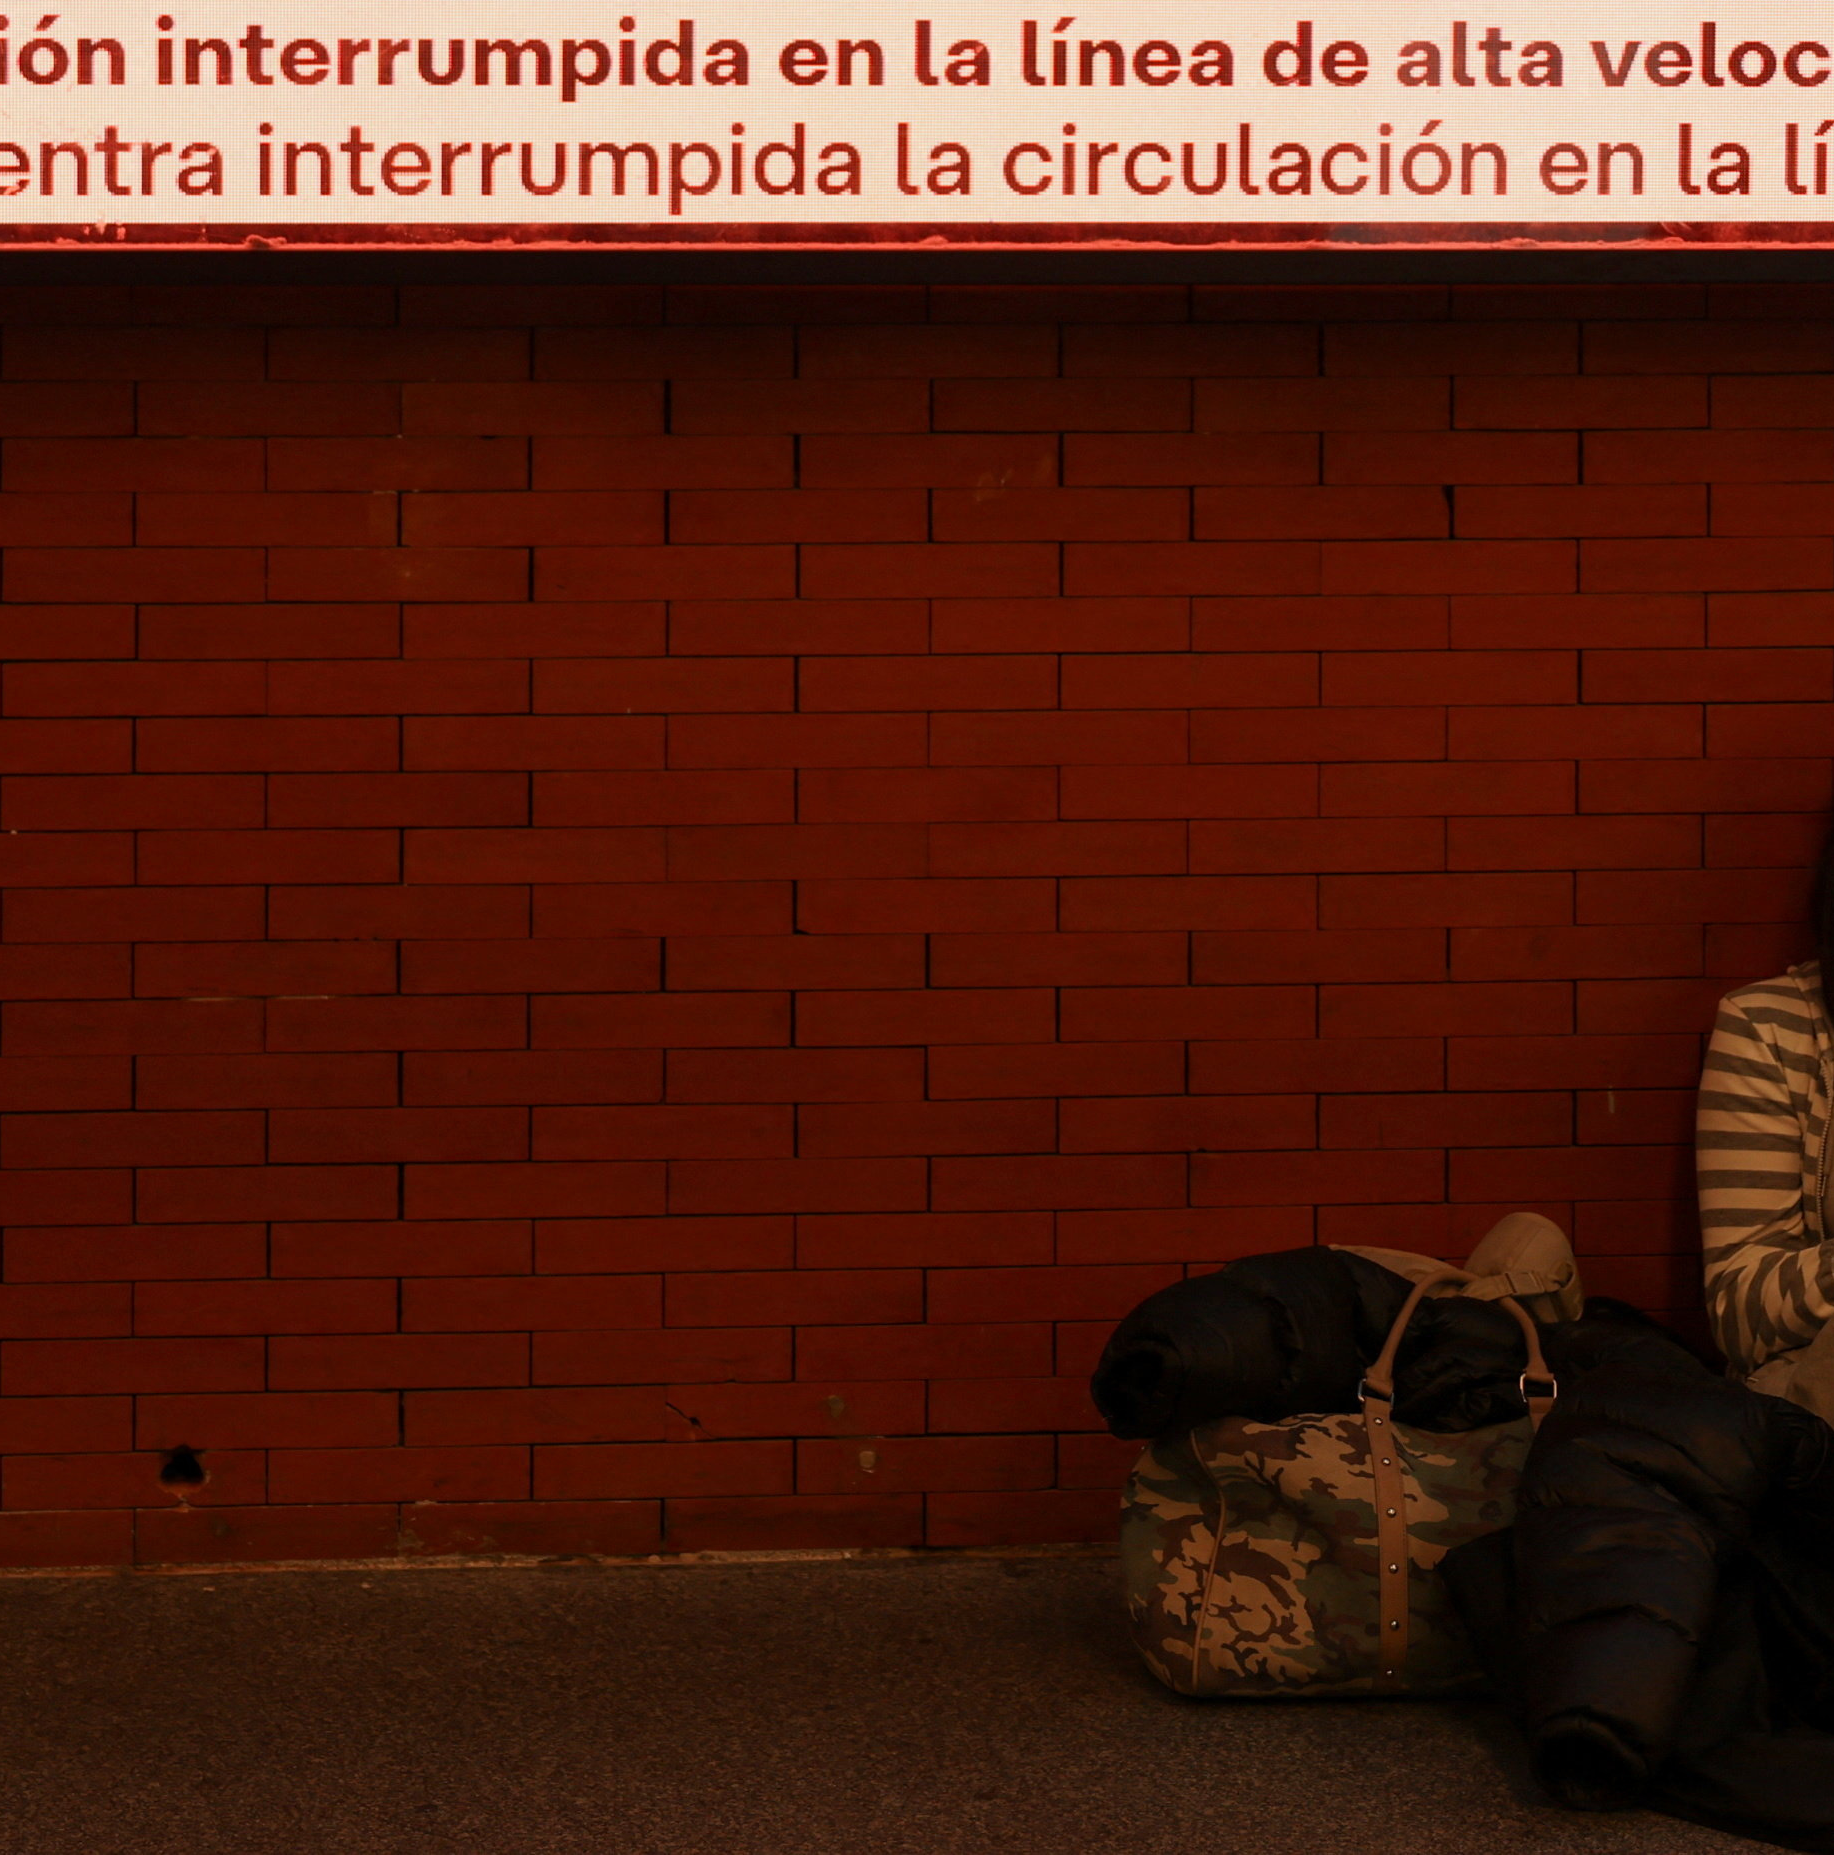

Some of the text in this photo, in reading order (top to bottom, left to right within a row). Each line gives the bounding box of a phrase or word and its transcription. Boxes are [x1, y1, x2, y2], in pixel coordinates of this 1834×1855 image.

[155, 14, 749, 103] interrumpida
[778, 39, 884, 87] en
[915, 19, 990, 87] la
[1022, 16, 1234, 87] línea
[1262, 20, 1369, 87] de
[1397, 21, 1563, 87] alta
[258, 122, 861, 216] interrumpida
[897, 122, 971, 196] la
[1003, 119, 1507, 196] circulación
[1539, 142, 1644, 196] en
[1678, 122, 1751, 196] la
